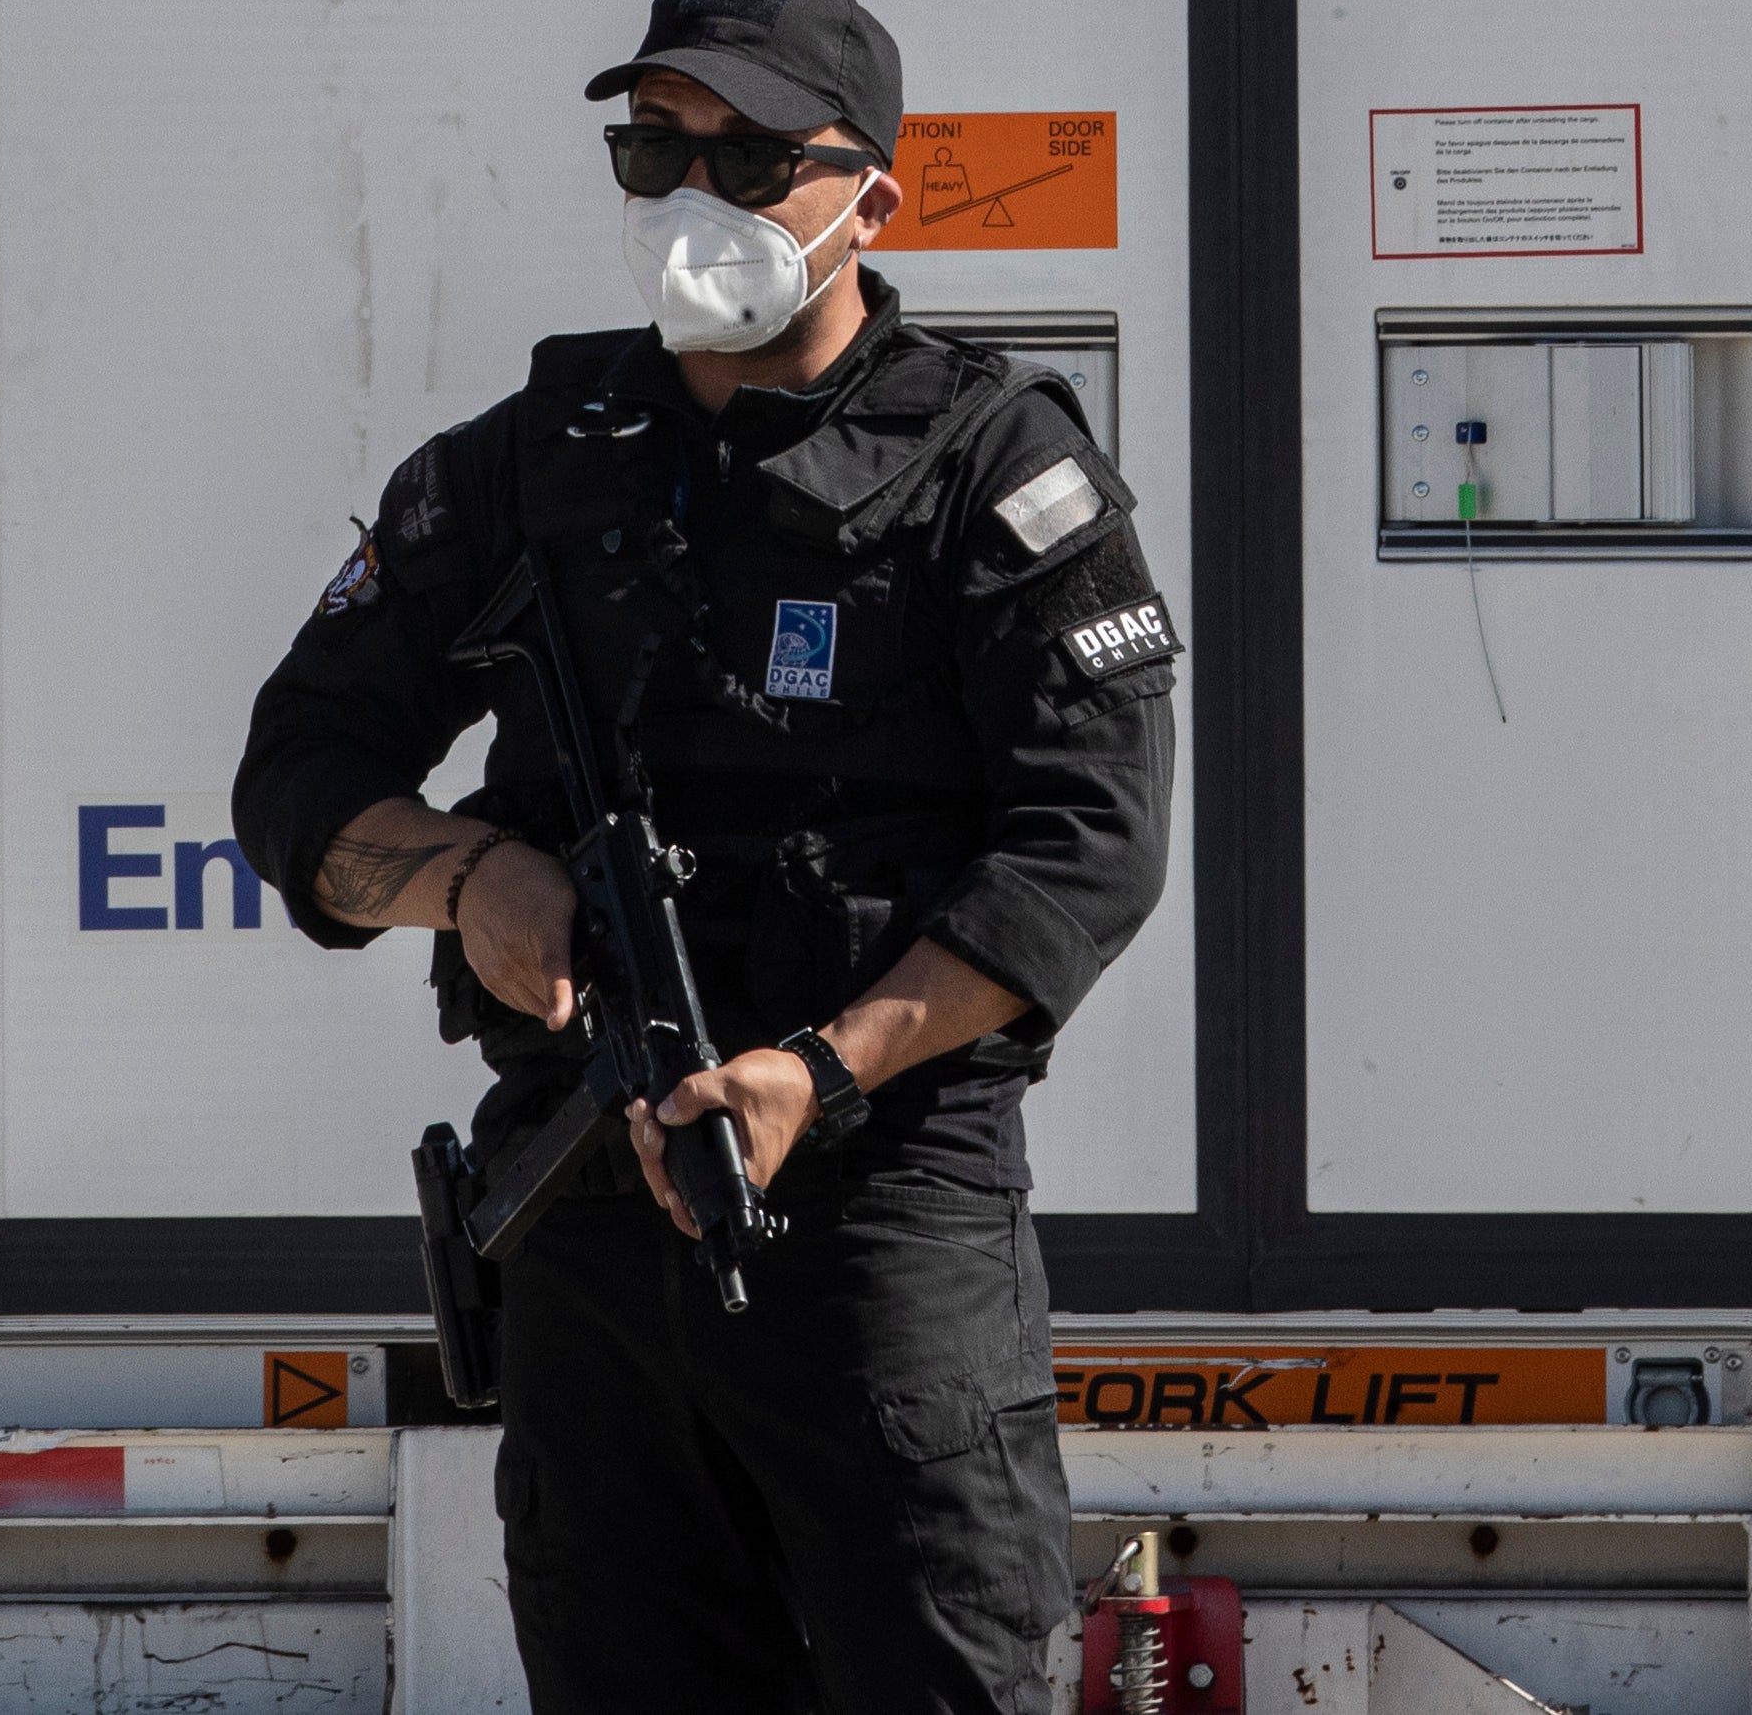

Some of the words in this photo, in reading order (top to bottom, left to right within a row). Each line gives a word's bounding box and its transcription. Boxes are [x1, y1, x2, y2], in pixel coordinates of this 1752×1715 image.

[897, 122, 962, 139] UTION!
[1049, 120, 1105, 137] DOOR
[1049, 141, 1092, 156] SIDE
[925, 181, 964, 192] HEAVY
[1073, 605, 1163, 658] DGAC
[1092, 633, 1170, 668] CHILE
[770, 668, 828, 687] DGAC
[768, 684, 827, 697] CHILE
[78, 804, 262, 931] En
[1054, 1371, 1276, 1425] FORK
[1310, 1372, 1500, 1425] LIFT
